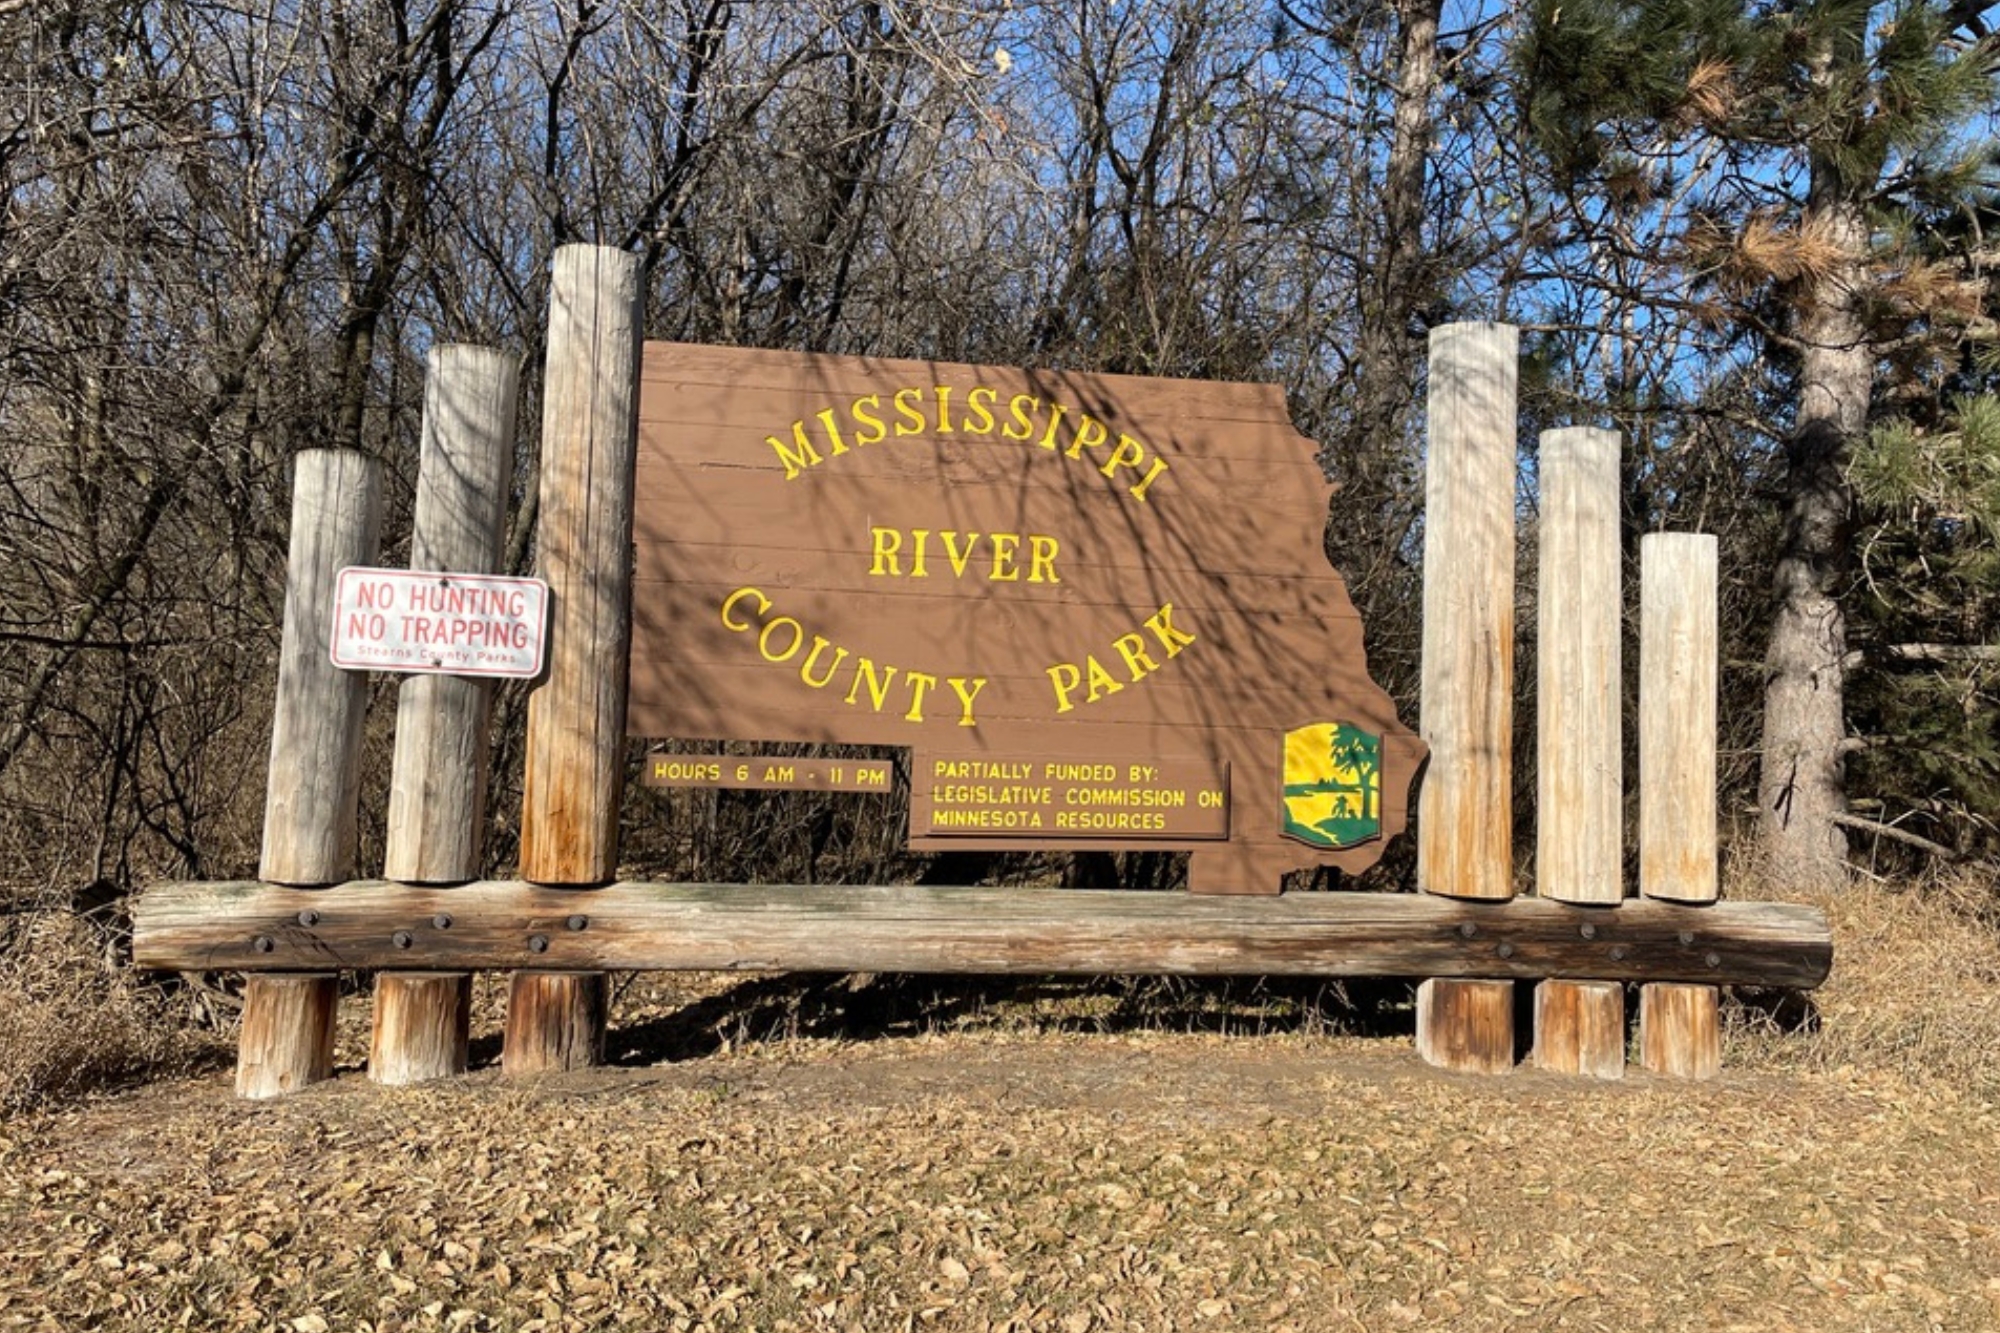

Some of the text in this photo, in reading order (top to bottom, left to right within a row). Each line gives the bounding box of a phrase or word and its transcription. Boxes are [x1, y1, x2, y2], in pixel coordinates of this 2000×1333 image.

[766, 386, 1169, 501] MISSISSIPPI
[869, 527, 1061, 584] RIVER
[357, 582, 525, 617] NO HUNTING
[348, 613, 528, 649] NO TRAPPING
[357, 645, 516, 663] Stearns County Parks
[721, 587, 1196, 726] COUNTY PARK
[654, 763, 720, 781] HOURS
[735, 766, 749, 782] 6
[763, 765, 795, 783] AM
[857, 769, 885, 785] PM
[935, 761, 1158, 783] PARTIALLY FUNDED BY:
[933, 786, 1223, 808] LEGISLATIVE COMMISSION ON
[932, 811, 1165, 829] MINNESOTA RESOURCES
